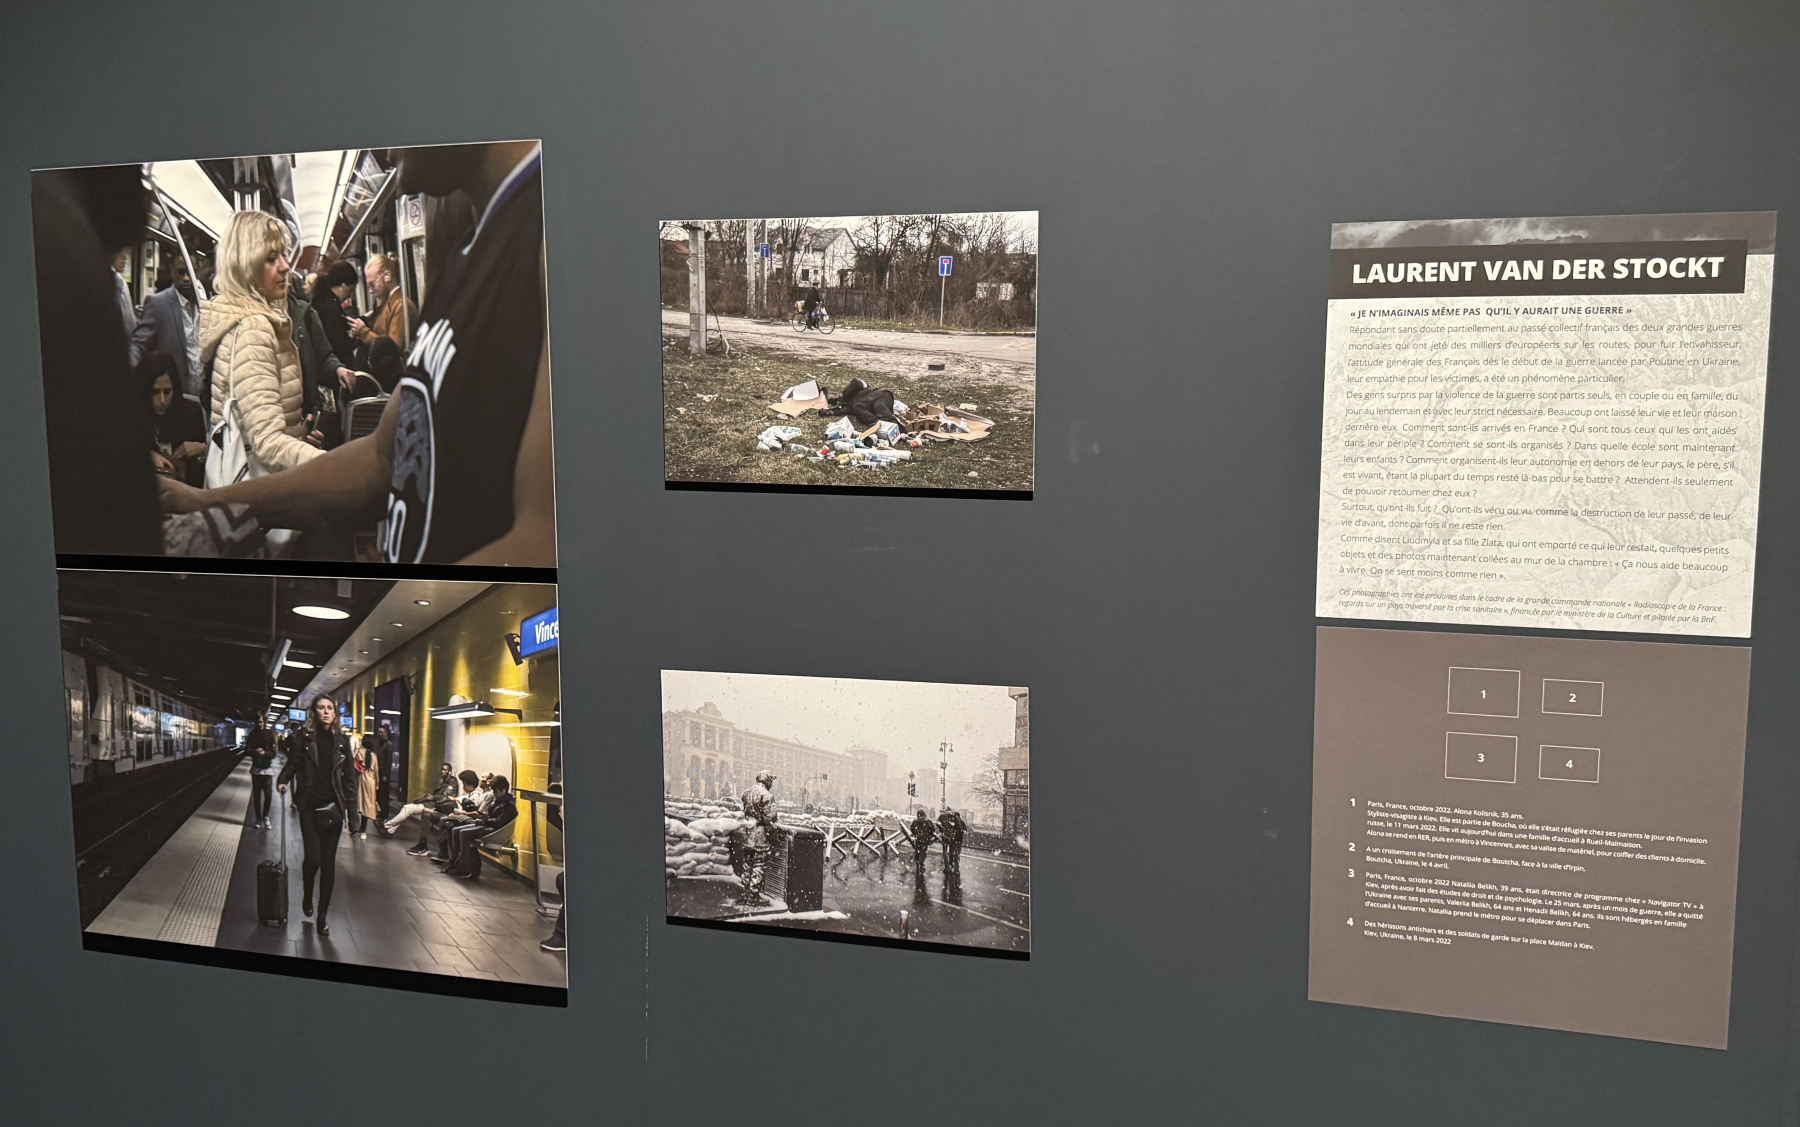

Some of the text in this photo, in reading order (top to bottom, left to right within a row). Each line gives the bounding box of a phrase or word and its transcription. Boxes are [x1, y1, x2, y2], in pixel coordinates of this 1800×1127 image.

[1353, 256, 1725, 283] LAURENT VAN DER STOCKT
[1357, 310, 1367, 319] JE
[1369, 309, 1429, 317] N'IMAGINAIS
[1432, 306, 1460, 316] MÊME
[1463, 308, 1481, 316] PAS
[1485, 307, 1512, 317] QU'IL
[1522, 307, 1559, 315] AURAIT
[1561, 306, 1582, 315] UNE
[1584, 306, 1624, 314] GUERRE
[1350, 325, 1396, 336] Répondant
[1420, 324, 1445, 333] doute
[1447, 324, 1505, 335] partiellement
[1521, 323, 1546, 334] passé
[1549, 323, 1584, 332] collectif
[1585, 323, 1620, 334] français
[1622, 323, 1639, 332] des
[1641, 322, 1665, 331] deux
[1666, 322, 1704, 334] grandes
[1706, 324, 1743, 333] guerres
[1347, 374, 1364, 383] leur
[1366, 374, 1405, 385] empathie
[1408, 376, 1428, 385] pour
[1431, 374, 1442, 382] les
[1492, 374, 1505, 382] été
[1522, 374, 1575, 385] phénomène
[1386, 471, 1408, 480] étant
[1411, 471, 1418, 480] la
[1420, 472, 1451, 482] plupart
[1453, 472, 1464, 481] du
[1467, 473, 1494, 483] temps
[1497, 473, 1519, 482] resté
[1521, 473, 1547, 482] là-bas
[1550, 476, 1571, 484] pour
[1586, 474, 1613, 484] battre
[1624, 476, 1683, 485] Attendent-ils
[1684, 477, 1734, 486] seulement
[1342, 486, 1353, 495] de
[1355, 487, 1388, 497] pouvoir
[1390, 488, 1430, 496] retourner
[1432, 488, 1452, 497] chez
[1370, 566, 1383, 575] On
[1417, 569, 1443, 577] moins
[1480, 571, 1496, 579] rien
[1480, 690, 1486, 698] 1
[1568, 694, 1576, 702] 2
[1478, 752, 1484, 762] 3
[1566, 760, 1574, 768] 4
[1350, 798, 1356, 806] 1
[1561, 826, 1588, 835] réfugiée
[1460, 828, 1496, 836] aujourd'hui
[1552, 835, 1579, 844] d'accueil
[1348, 842, 1356, 852] 2
[1382, 848, 1416, 856] croisement
[1450, 854, 1481, 863] principale
[1348, 868, 1354, 878] 3
[1346, 918, 1354, 926] 4
[1378, 922, 1407, 930] hérissons
